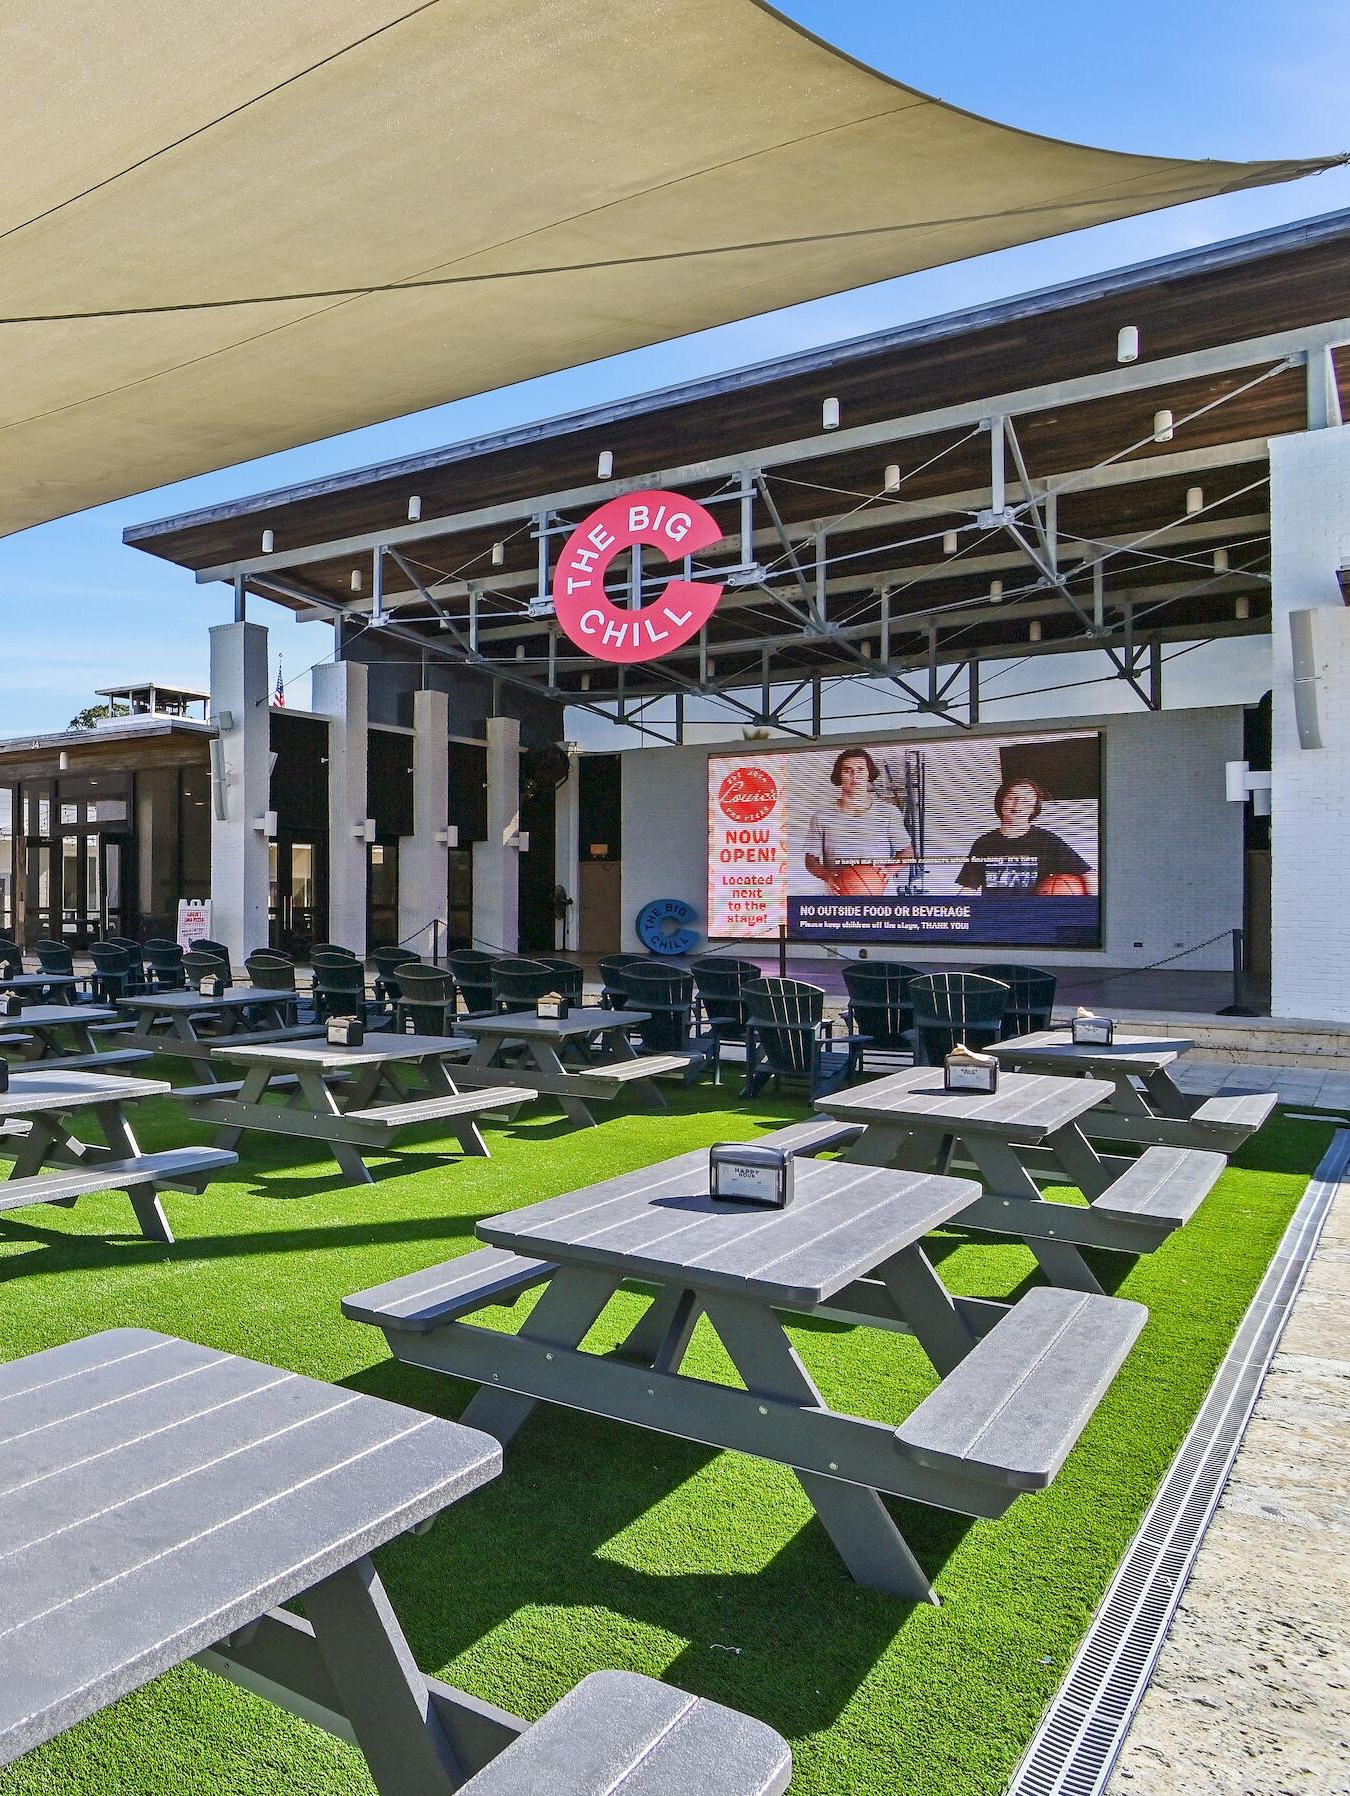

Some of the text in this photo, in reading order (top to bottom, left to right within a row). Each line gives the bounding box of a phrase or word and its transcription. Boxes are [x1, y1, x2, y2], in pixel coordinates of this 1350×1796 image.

[567, 505, 692, 595] THE BIG
[579, 607, 693, 648] CHILL
[725, 829, 770, 845] NOW
[720, 847, 777, 863] OPEN!
[722, 874, 773, 886] Located
[732, 888, 763, 899] next
[728, 901, 767, 911] to the
[800, 905, 970, 917] NO OUTSIDE FOOD OR BEVERAGE
[645, 903, 687, 931] THE BIG
[727, 913, 768, 927] stage!
[799, 920, 823, 928] Please
[824, 920, 841, 930] keep
[842, 921, 871, 929] children
[872, 921, 883, 929] off
[883, 921, 896, 929] the
[921, 921, 949, 929] THANK
[950, 922, 970, 930] YOU!
[650, 935, 689, 949] CHILL
[734, 1167, 760, 1176] HAPPY
